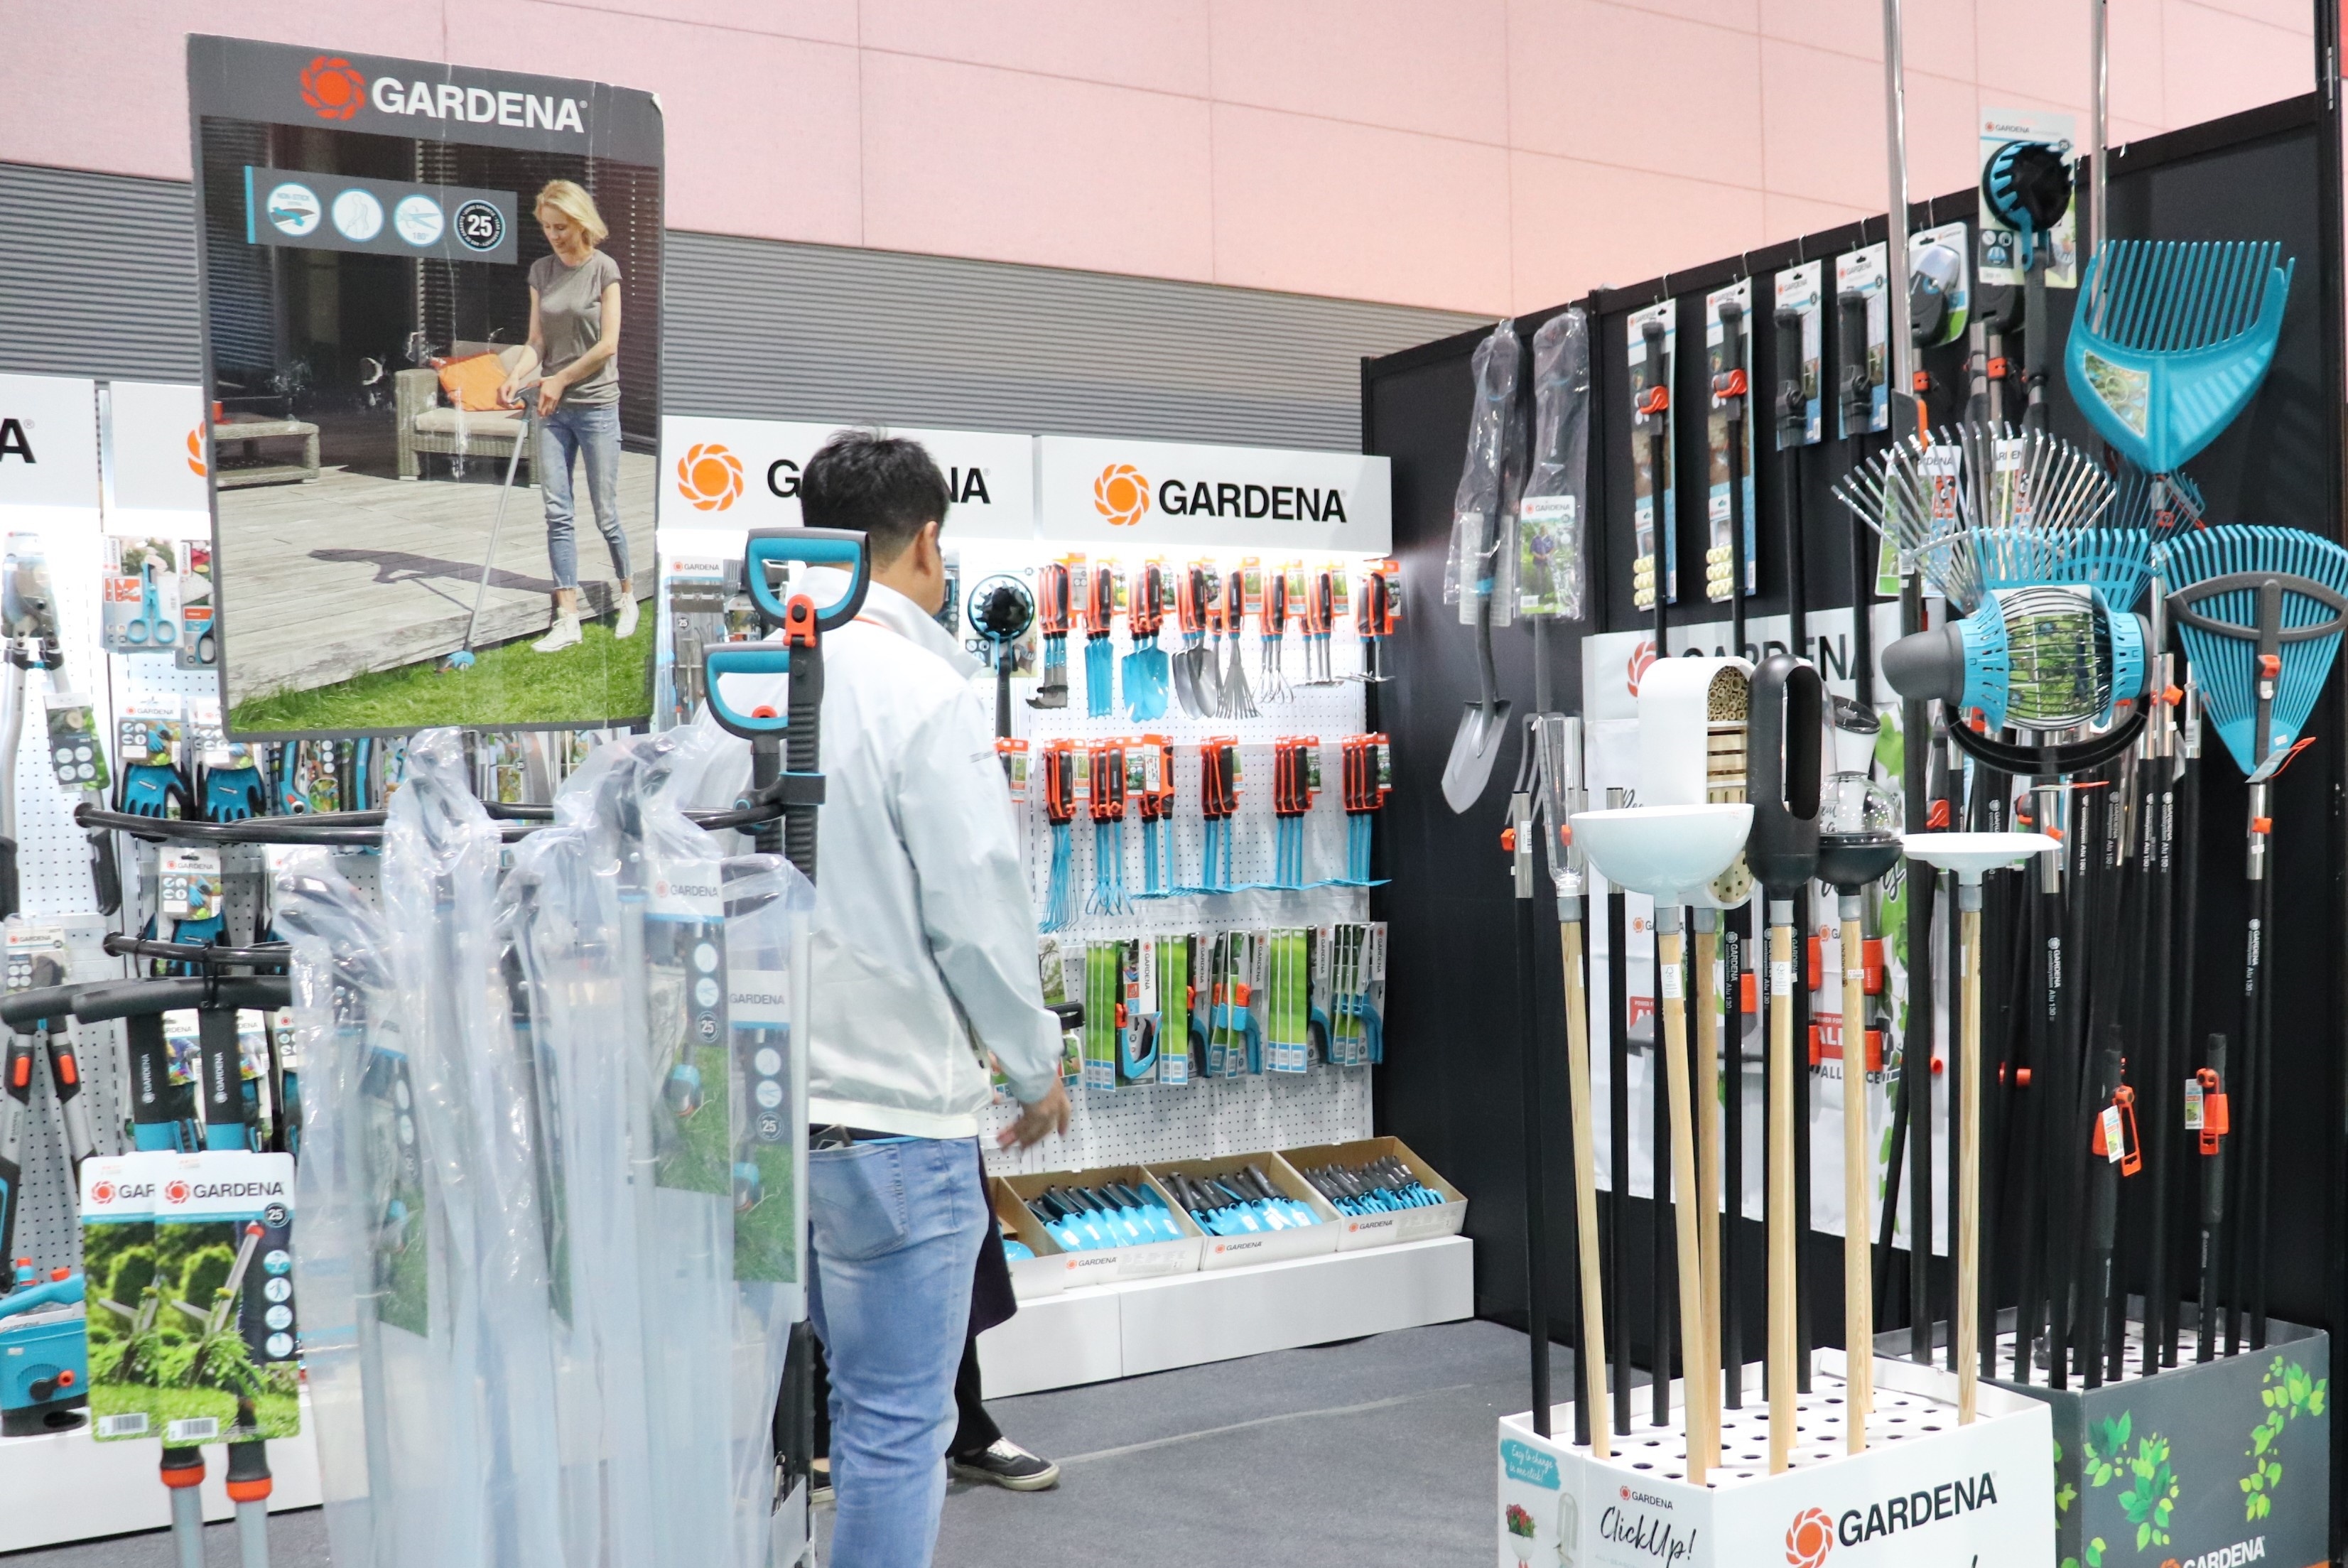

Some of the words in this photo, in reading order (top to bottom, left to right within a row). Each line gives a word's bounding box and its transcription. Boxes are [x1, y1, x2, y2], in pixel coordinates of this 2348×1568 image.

[372, 77, 585, 134] GARDENA
[1995, 124, 2030, 134] GARDENA
[468, 214, 492, 237] 25
[1159, 480, 1347, 524] GARDENA
[670, 885, 719, 897] GARDENA
[729, 994, 785, 1005] GARDENA
[700, 1020, 714, 1033] 25
[142, 1054, 153, 1094] GARDENA
[215, 1052, 225, 1094] GARDENA
[761, 1119, 777, 1134] 25
[193, 1182, 285, 1199] GARDENA
[268, 1209, 283, 1221] 25
[1360, 1220, 1392, 1229] GARDENA
[1226, 1241, 1262, 1251] GARDENA
[1078, 1257, 1116, 1267] GARDENA
[1510, 1461, 1515, 1473] in
[1512, 1444, 1525, 1465] Easy
[1525, 1449, 1532, 1461] to
[1532, 1451, 1553, 1474] change
[1631, 1491, 1674, 1510] GARDENA
[1838, 1471, 1998, 1547] GARDENA
[1600, 1505, 1697, 1568] ClickUp!
